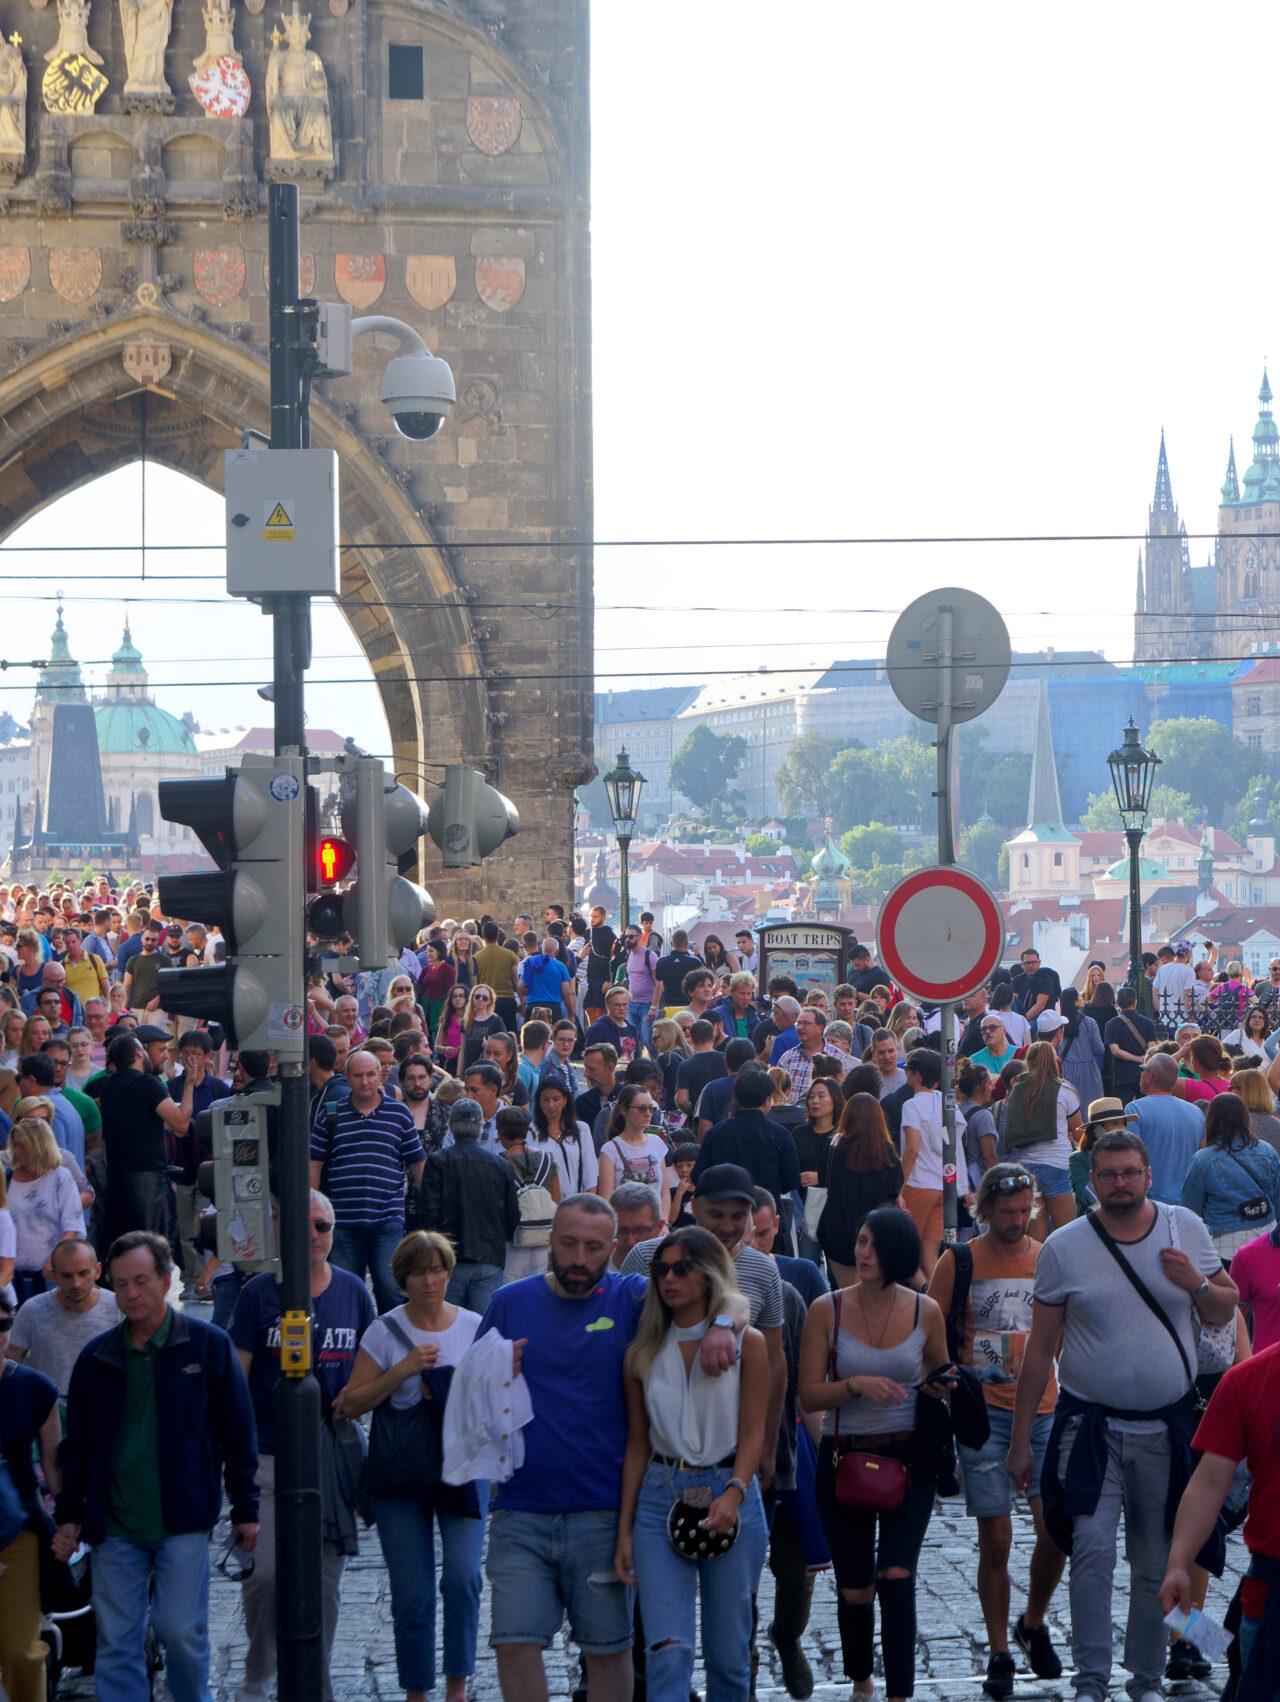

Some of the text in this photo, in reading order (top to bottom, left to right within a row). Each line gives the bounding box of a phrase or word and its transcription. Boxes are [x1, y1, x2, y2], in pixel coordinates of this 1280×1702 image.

[767, 933, 841, 945] BOAT TRIPS
[979, 1290, 1001, 1318] SURF
[1004, 1288, 1020, 1298] and
[979, 1339, 1002, 1365] SURF
